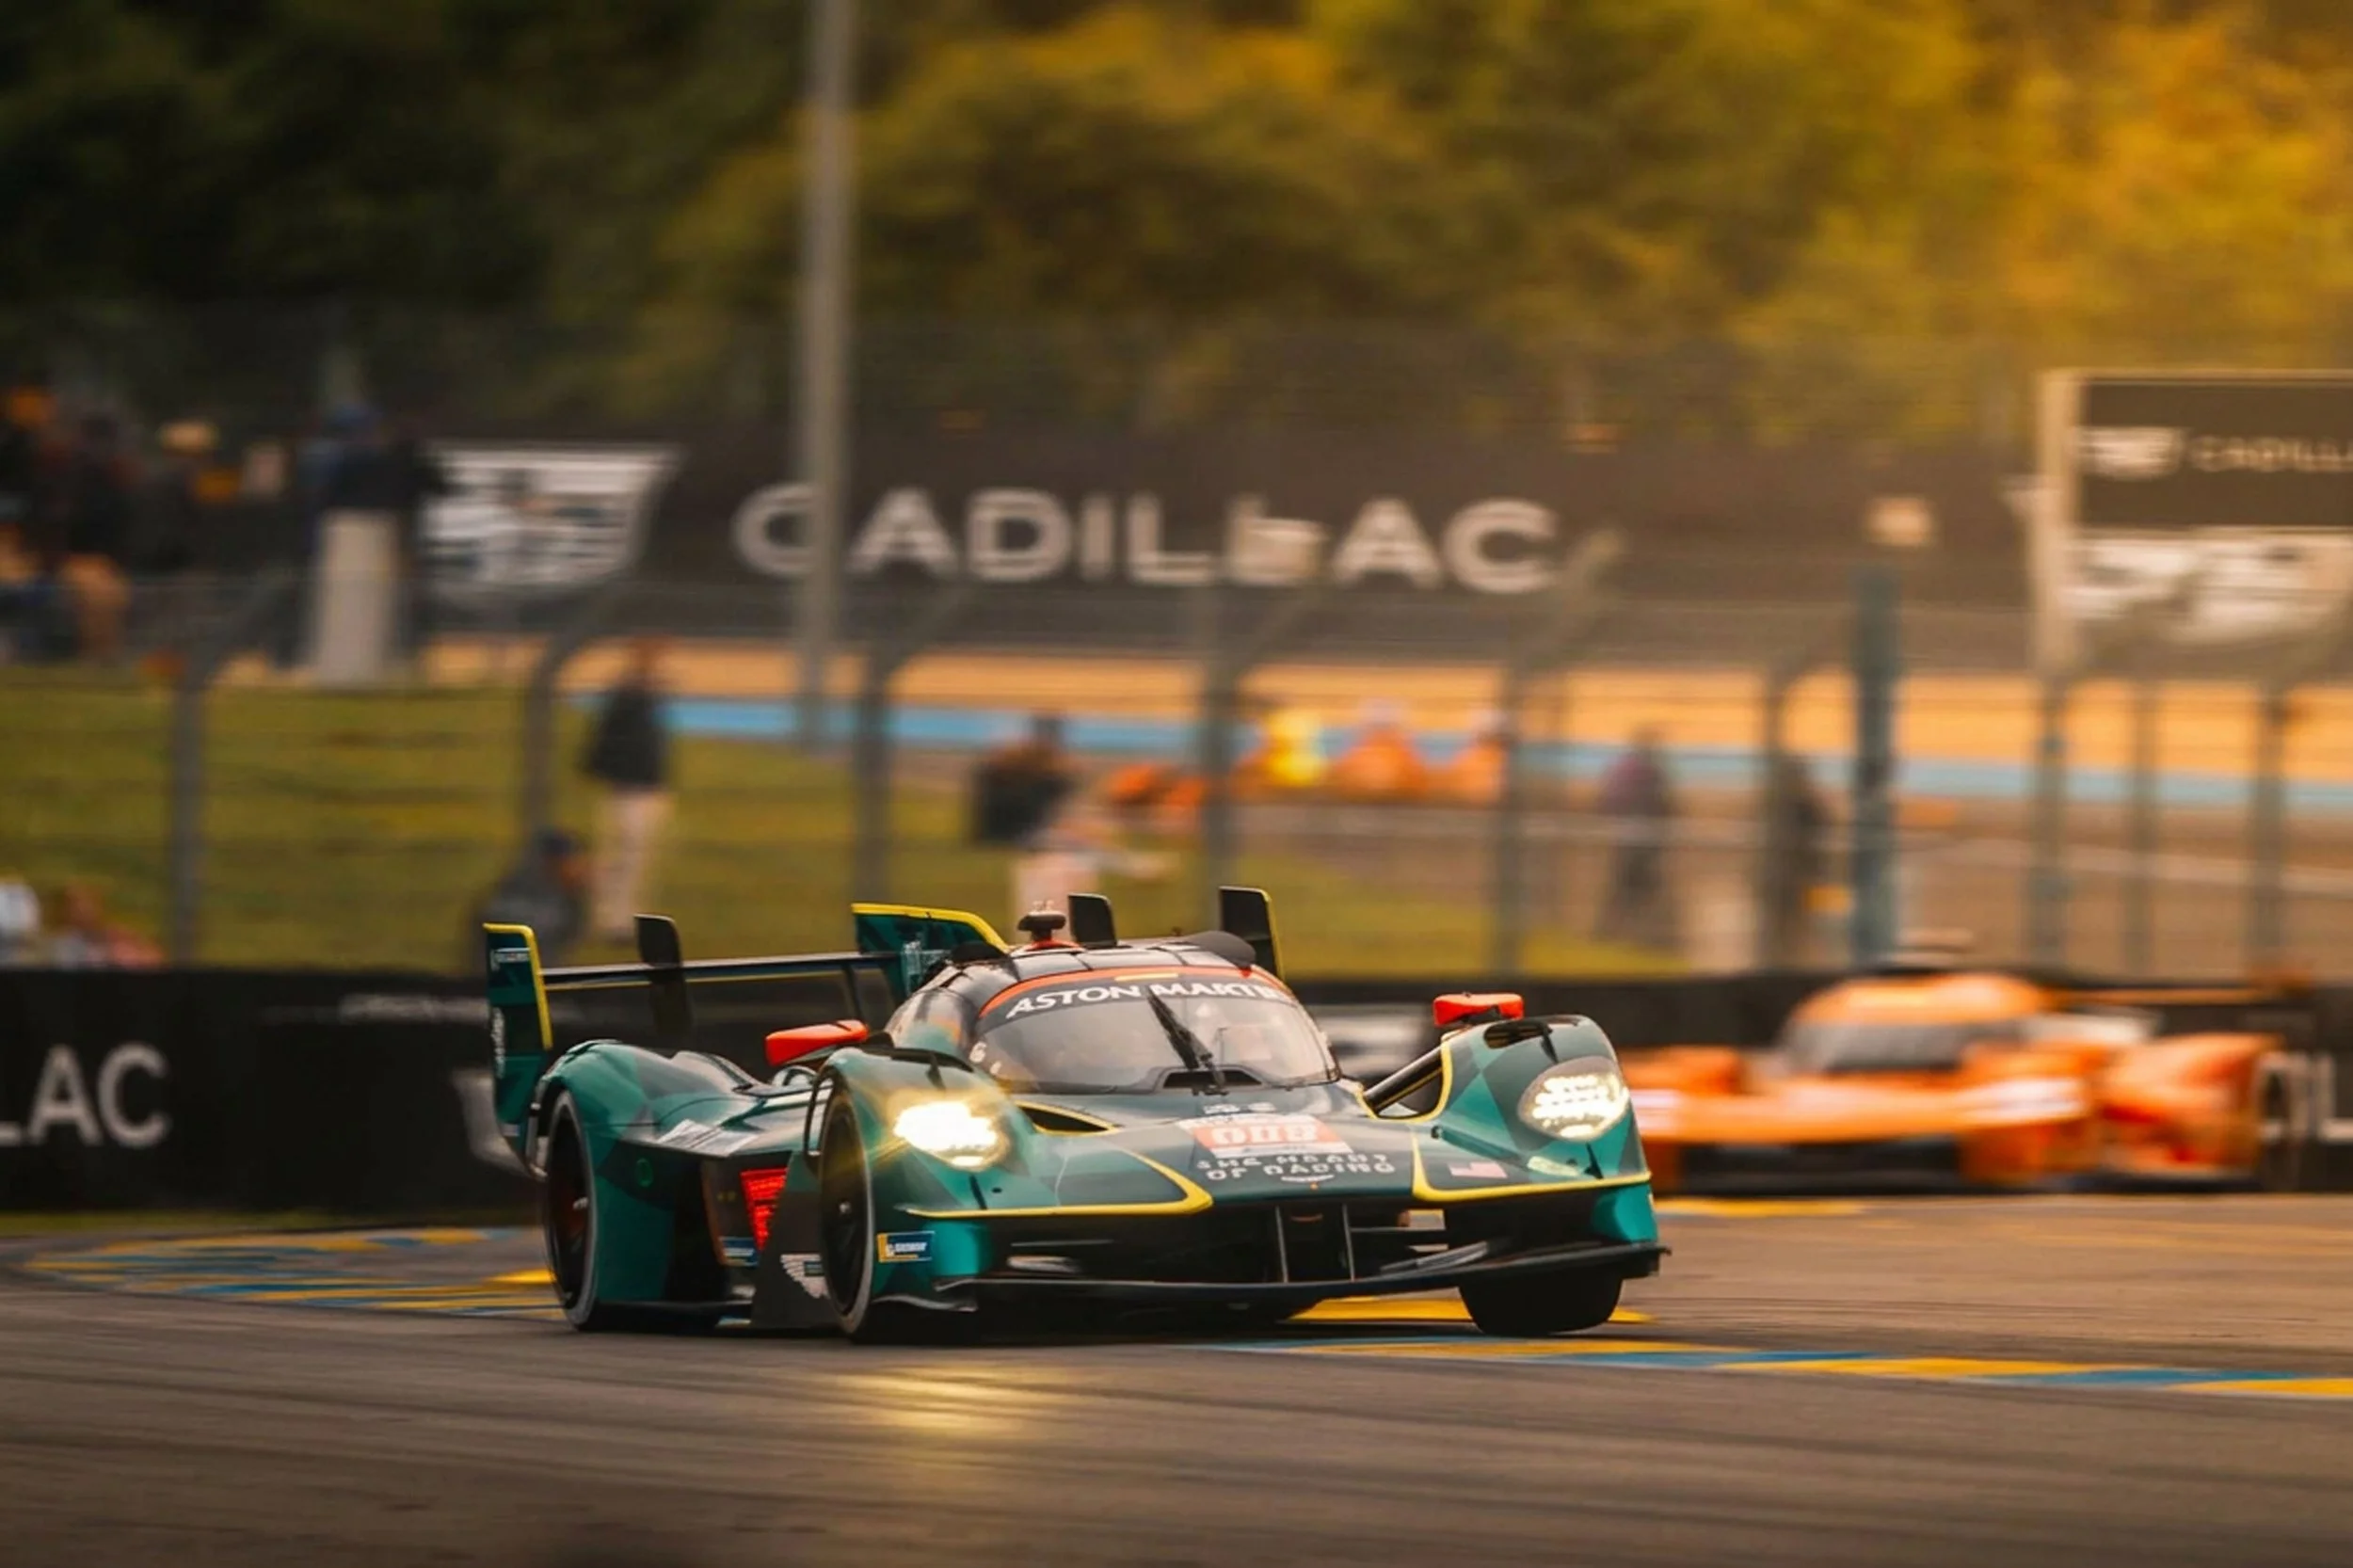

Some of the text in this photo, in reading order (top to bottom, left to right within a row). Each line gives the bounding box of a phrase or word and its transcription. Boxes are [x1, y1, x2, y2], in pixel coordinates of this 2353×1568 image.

[732, 481, 1558, 595] CADILLAC
[1005, 985, 1142, 1019] ASTON
[0, 1043, 169, 1147] AC
